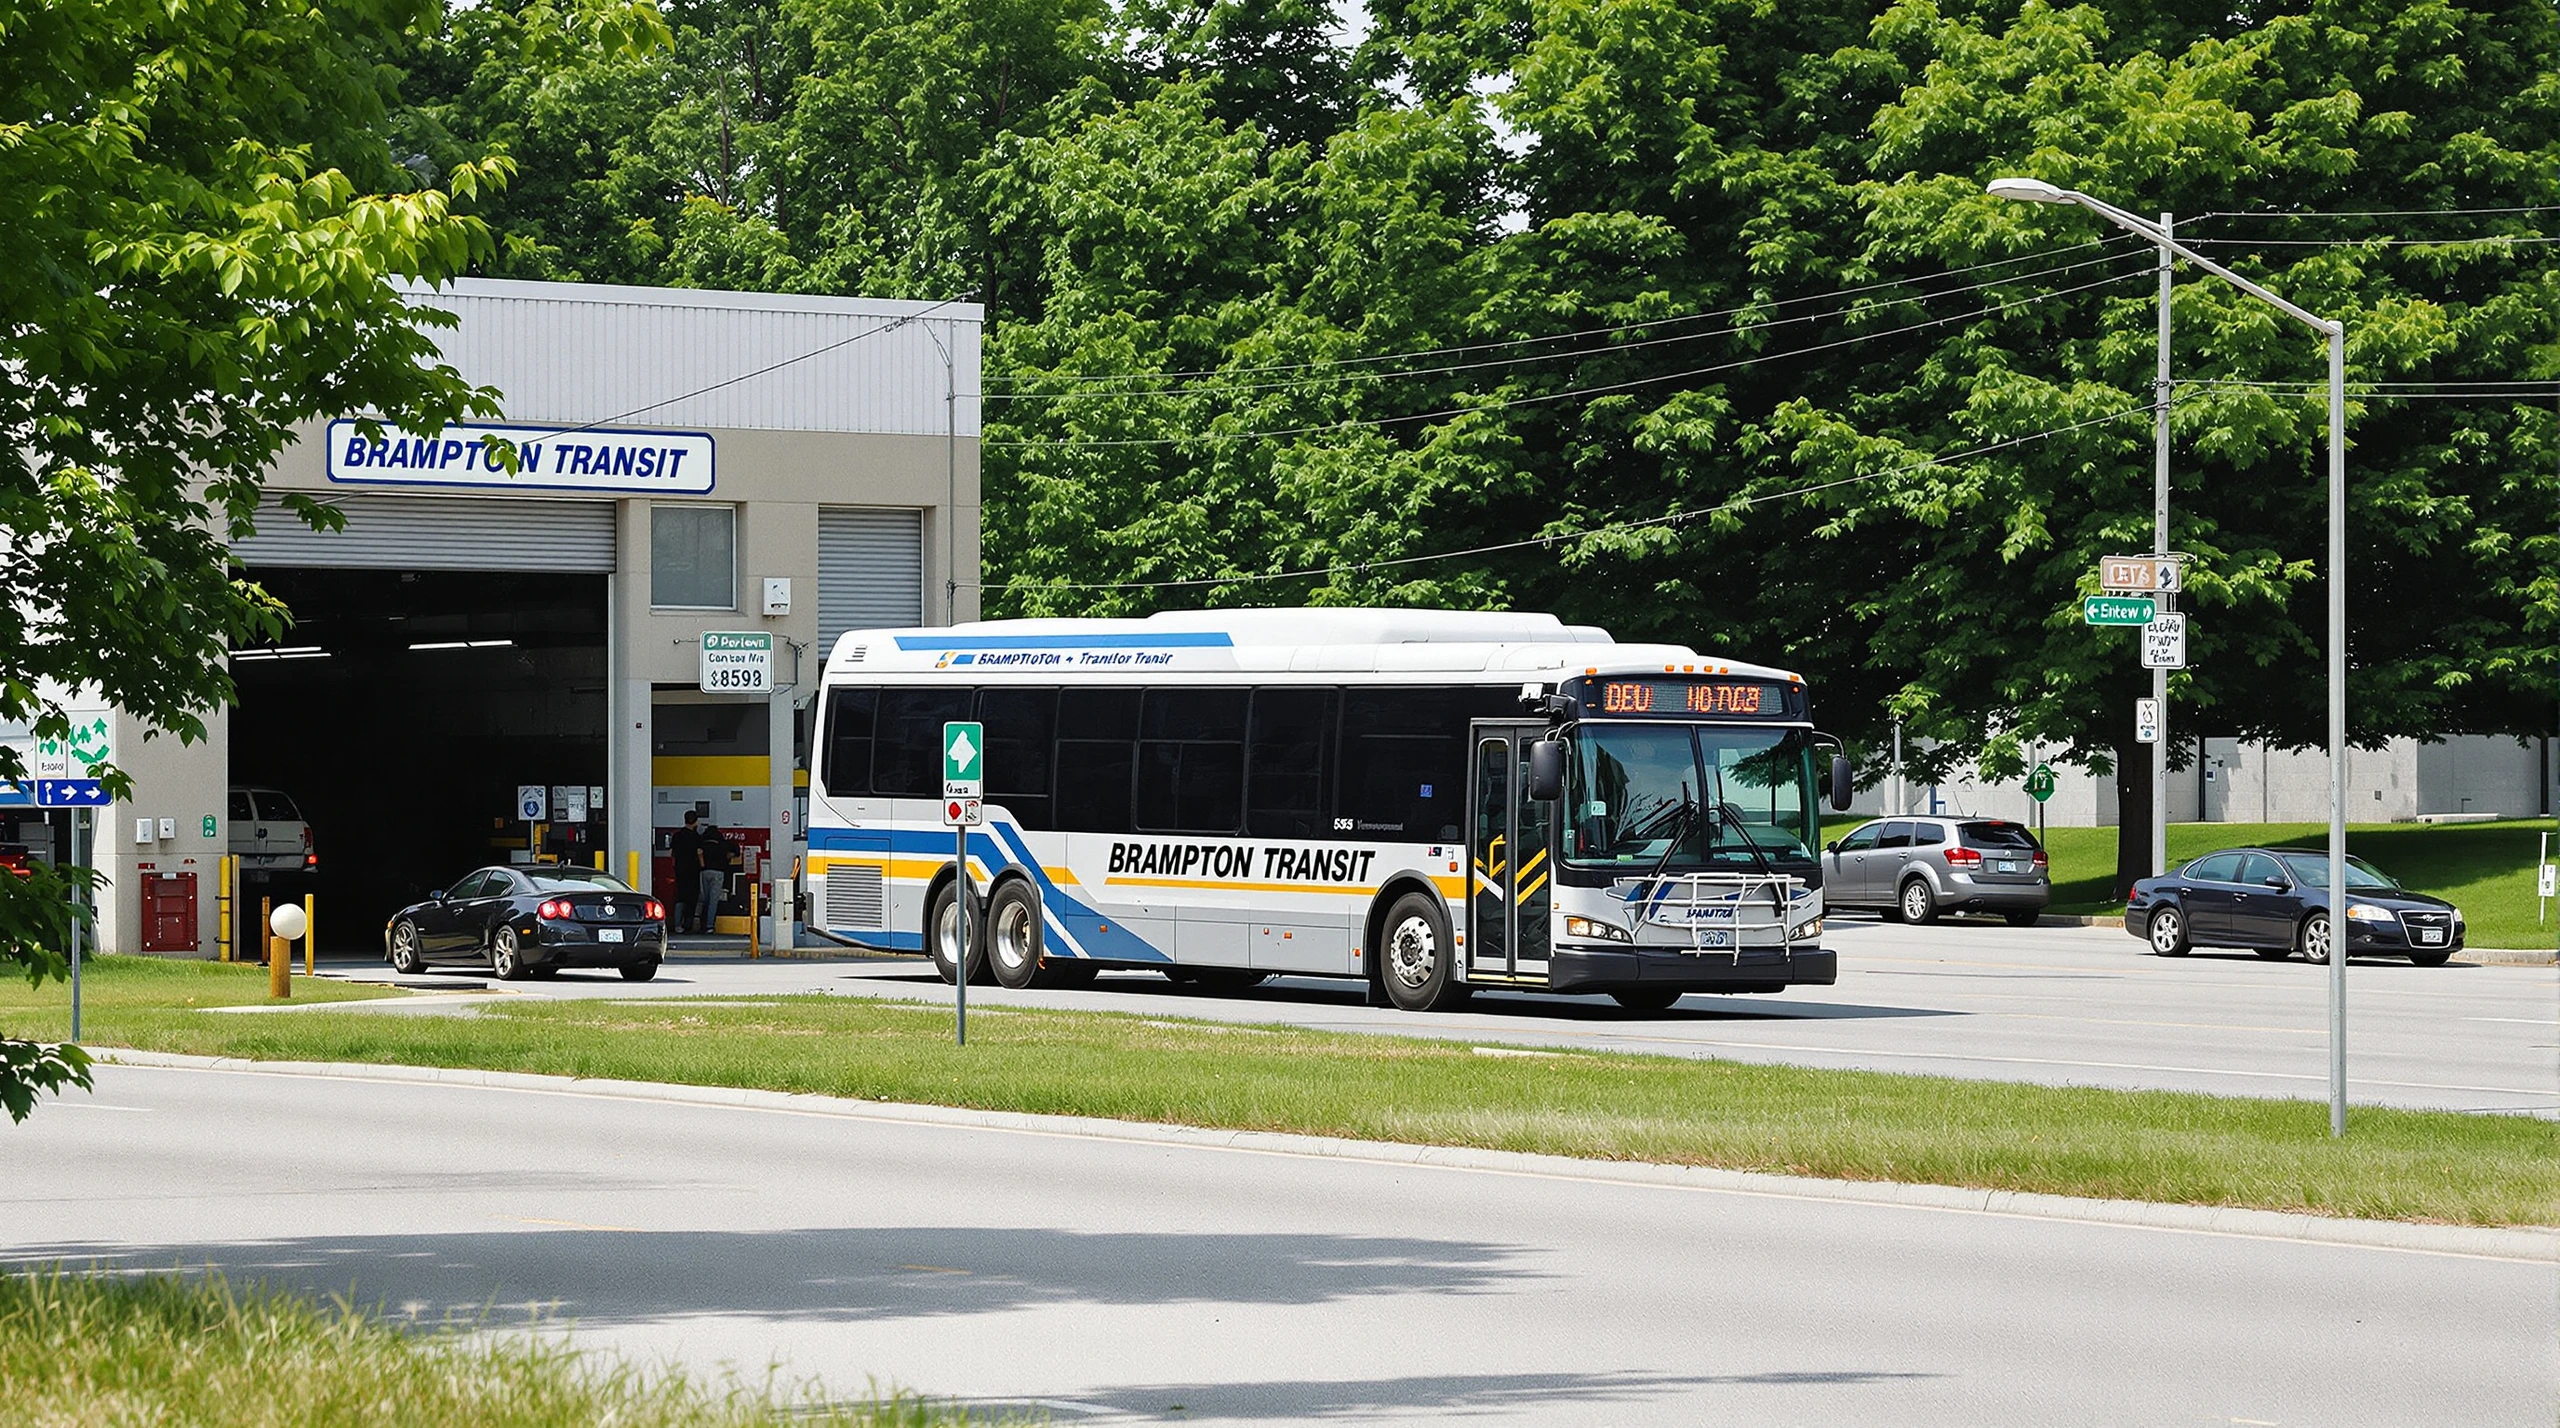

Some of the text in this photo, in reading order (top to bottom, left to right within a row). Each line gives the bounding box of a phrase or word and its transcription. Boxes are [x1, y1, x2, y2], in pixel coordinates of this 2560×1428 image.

[554, 444, 688, 479] TRANSIT
[1108, 842, 1376, 882] BRAMPTON TRANSIT
